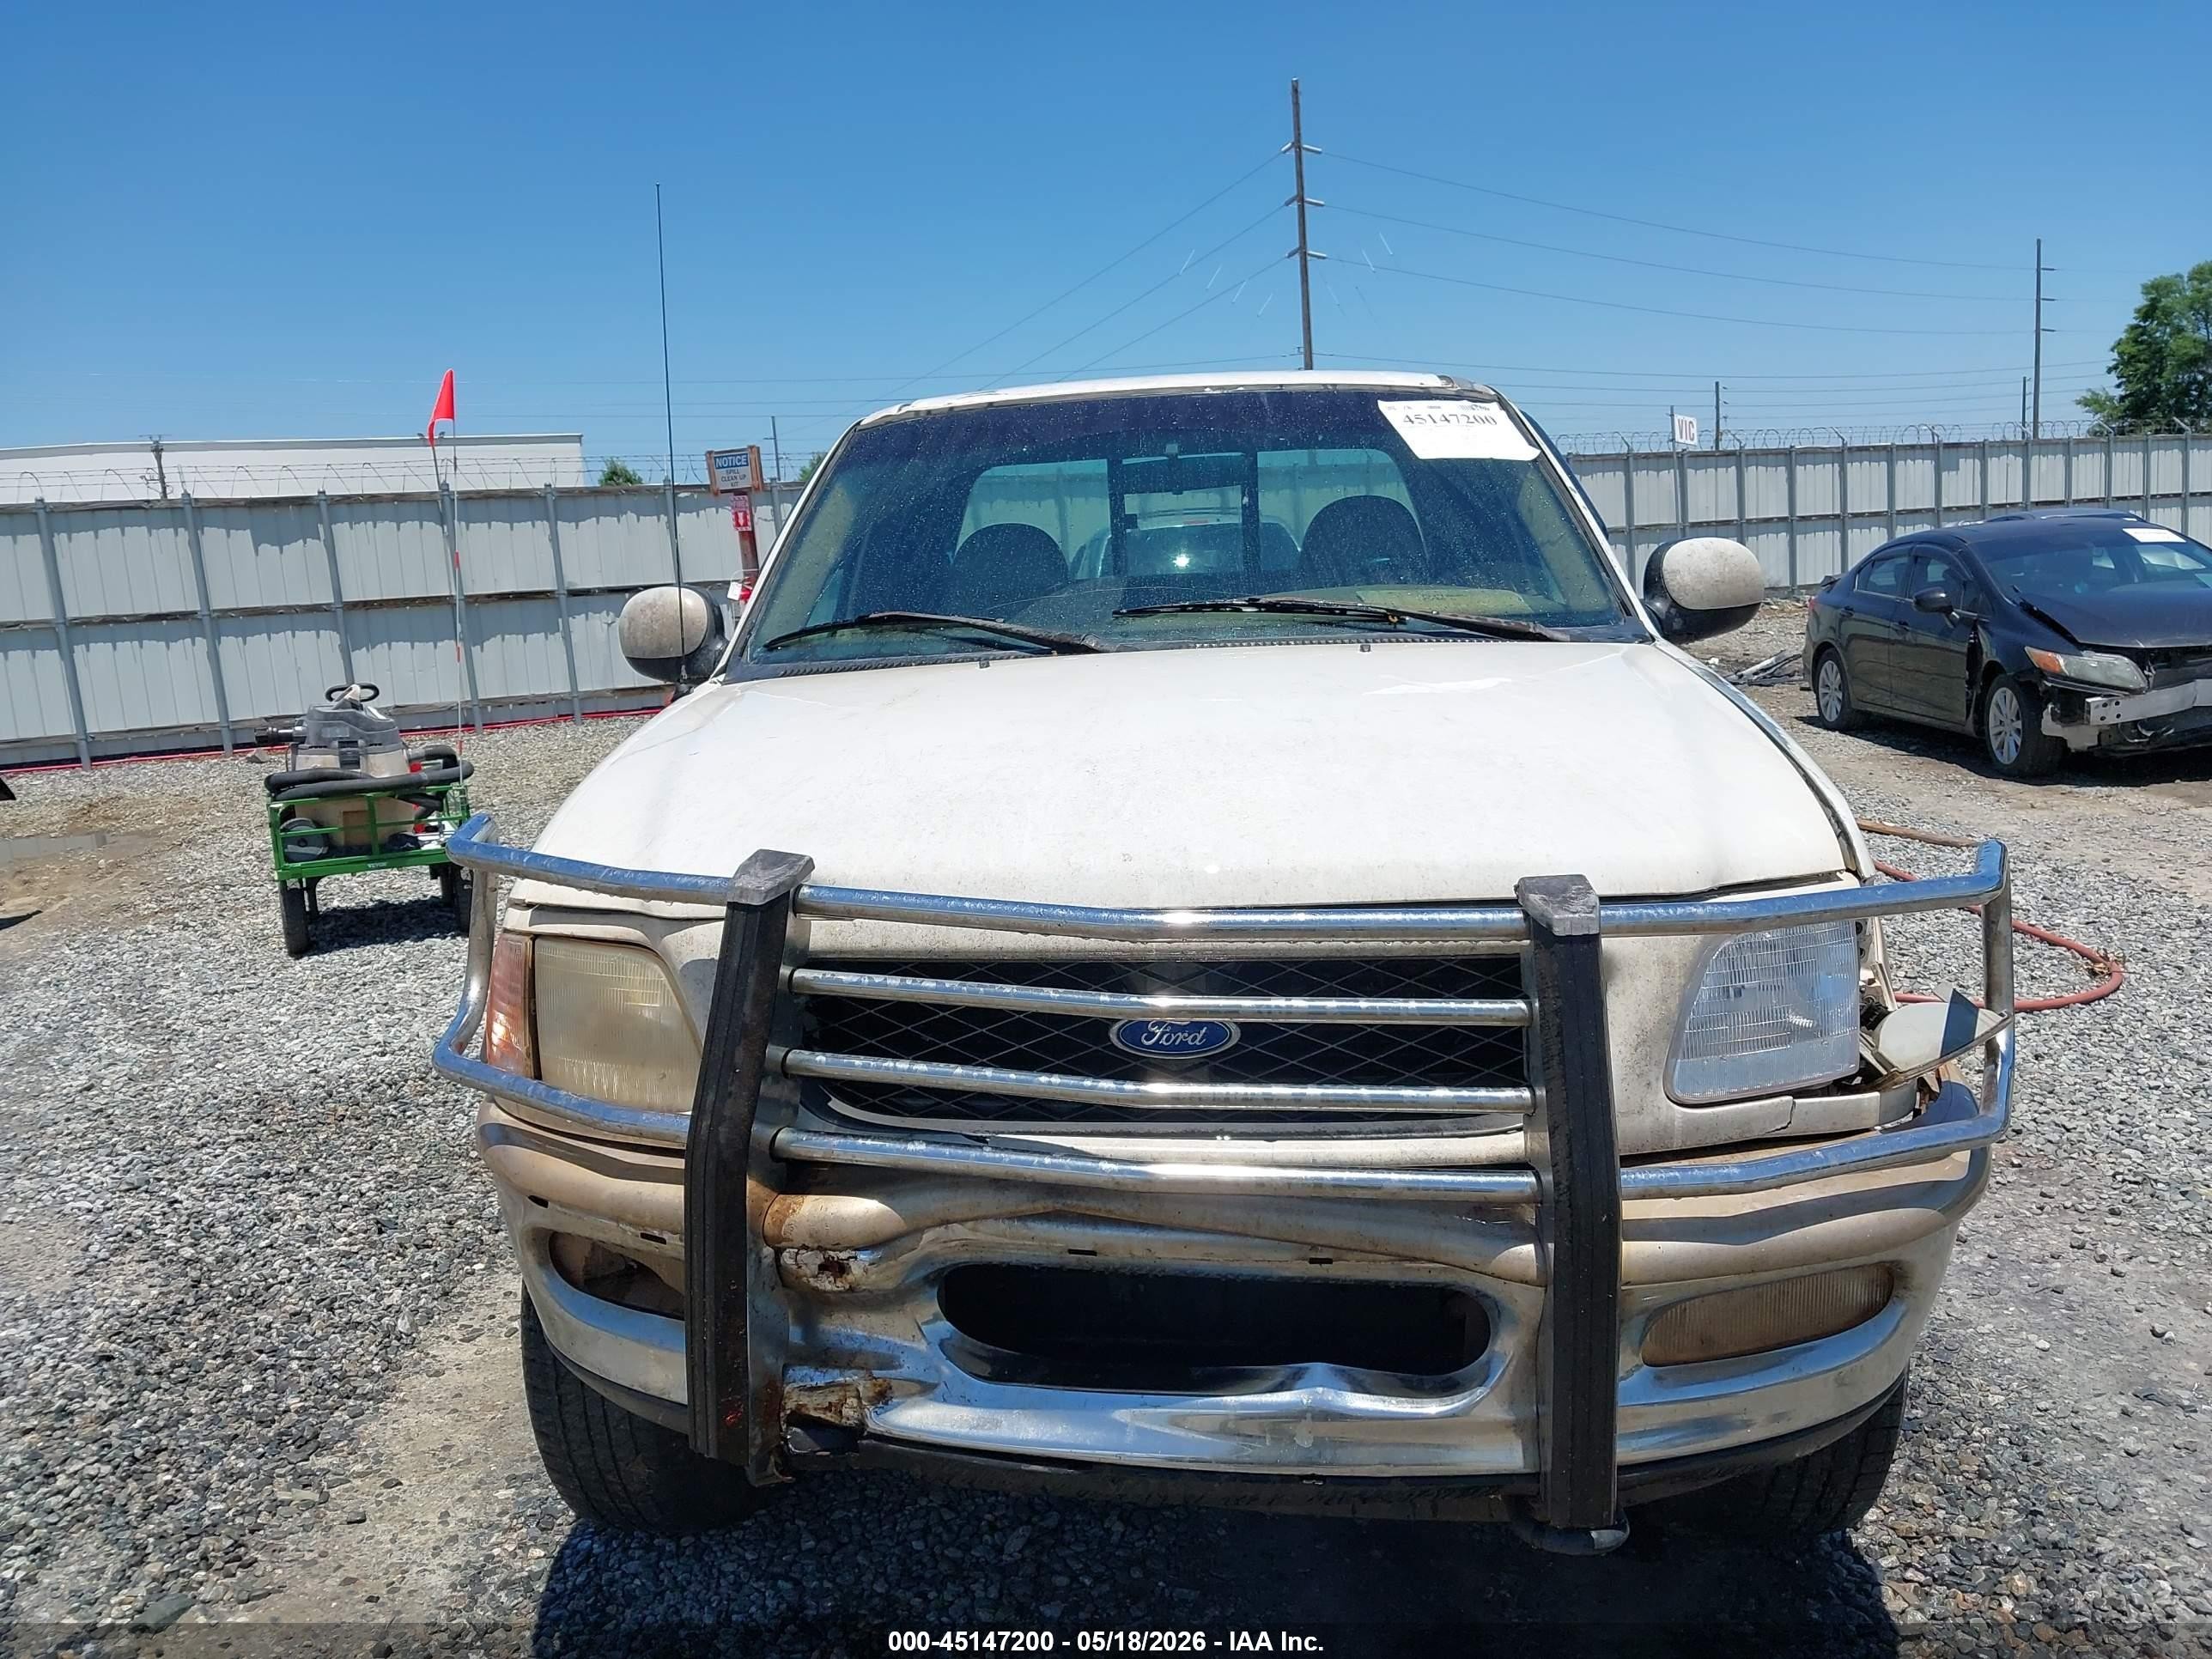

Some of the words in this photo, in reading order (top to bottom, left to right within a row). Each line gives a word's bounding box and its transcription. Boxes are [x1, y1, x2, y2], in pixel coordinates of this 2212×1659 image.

[1403, 413, 1498, 426] 45147200
[1677, 418, 1695, 441] VIC
[716, 454, 747, 468] NOTICE
[1141, 1019, 1207, 1046] Ford
